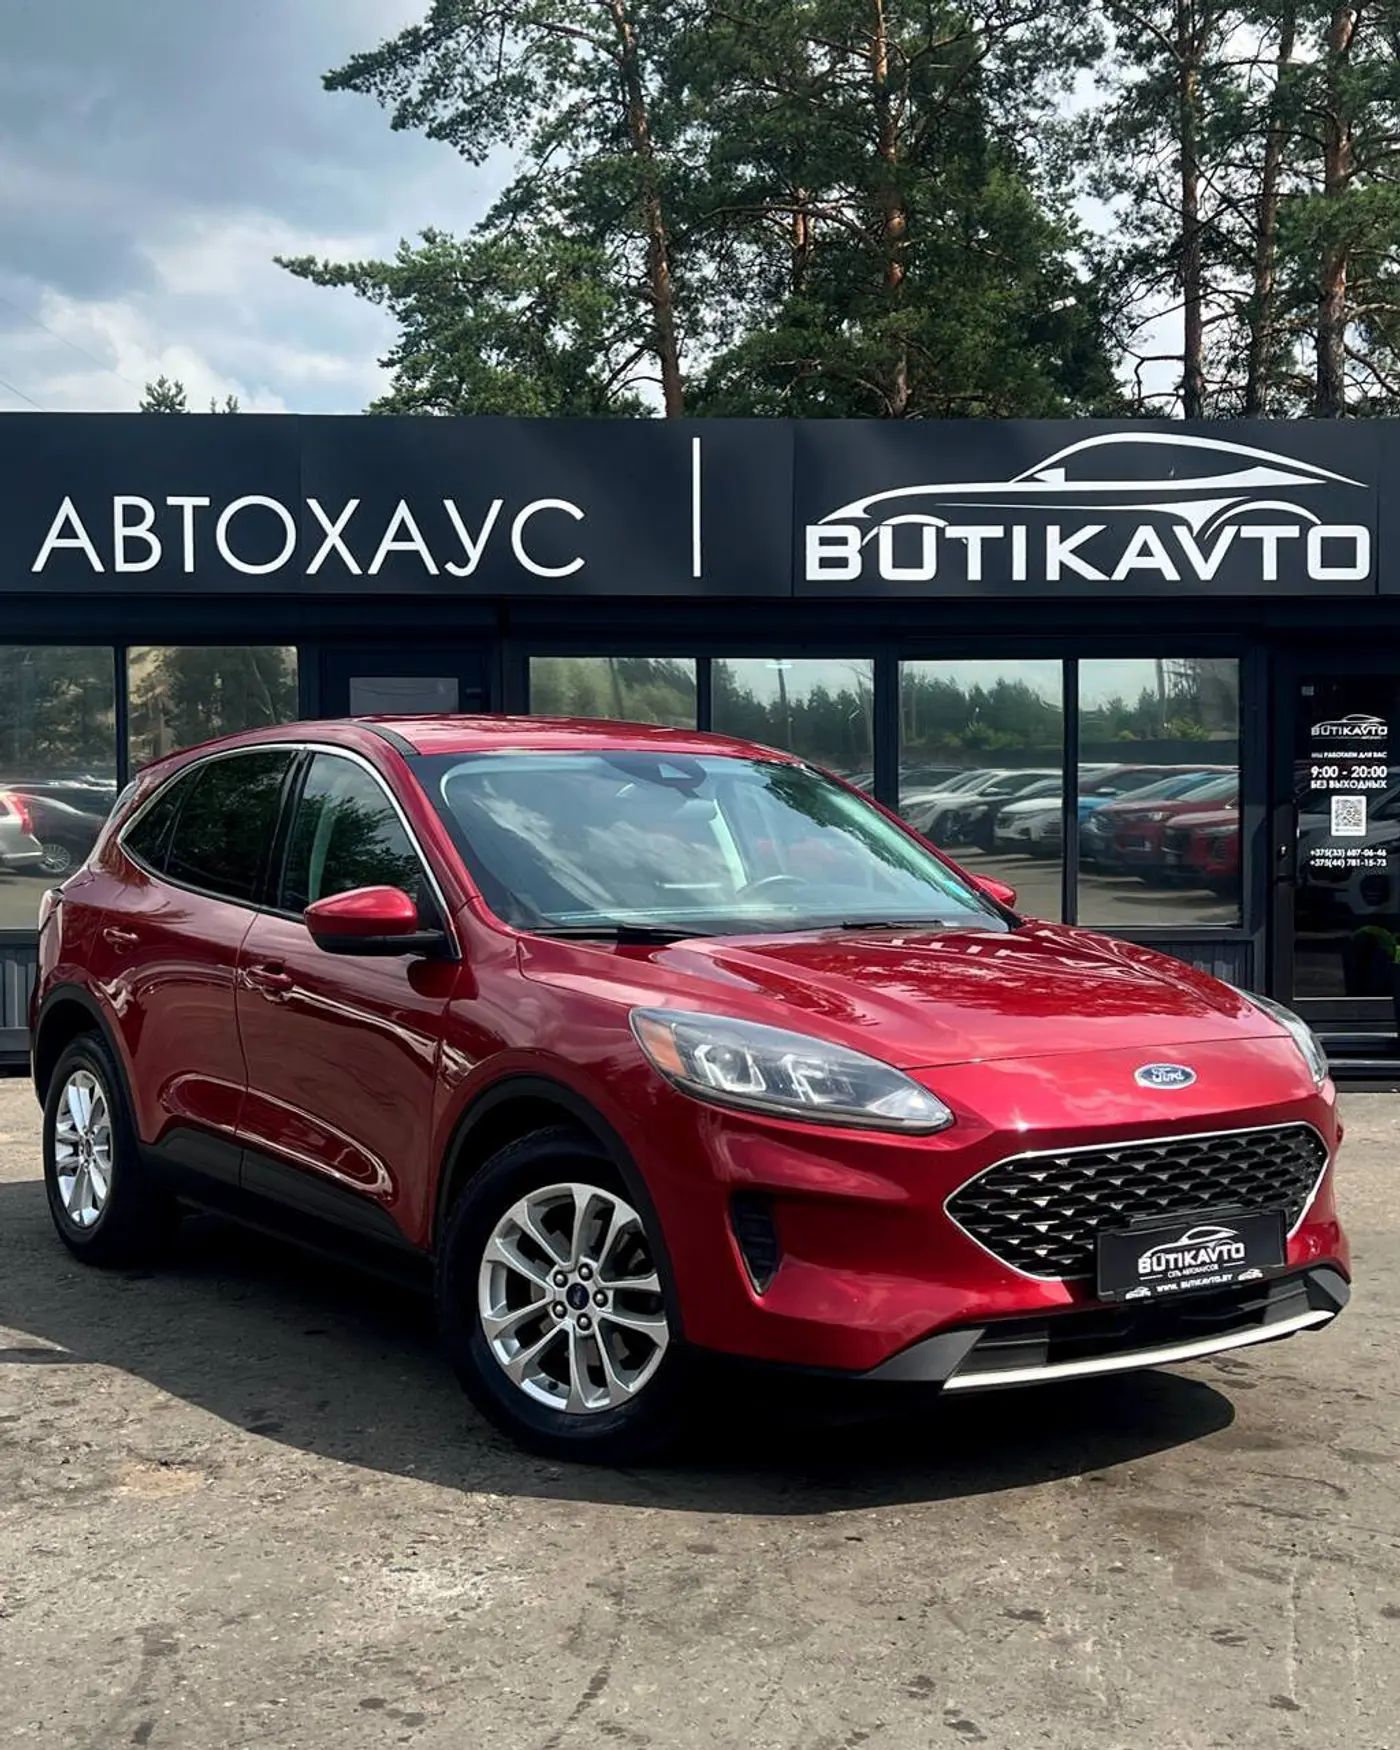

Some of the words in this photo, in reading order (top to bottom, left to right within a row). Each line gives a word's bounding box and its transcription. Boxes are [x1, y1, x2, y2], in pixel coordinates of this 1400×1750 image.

[31, 495, 586, 578] АВТОХАУС
[805, 524, 1371, 581] BUTIKAVTO
[1311, 726, 1388, 736] BUTIKAVTO
[1310, 765, 1339, 778] 9:00
[1350, 765, 1388, 778] 20:00
[1310, 780, 1328, 789] БЕЗ
[1328, 780, 1388, 789] ВЫХОДНЫХ
[1310, 858, 1346, 868] +375(44)
[1151, 1067, 1186, 1083] Ford
[1138, 1242, 1245, 1274] BUTIKAVTO
